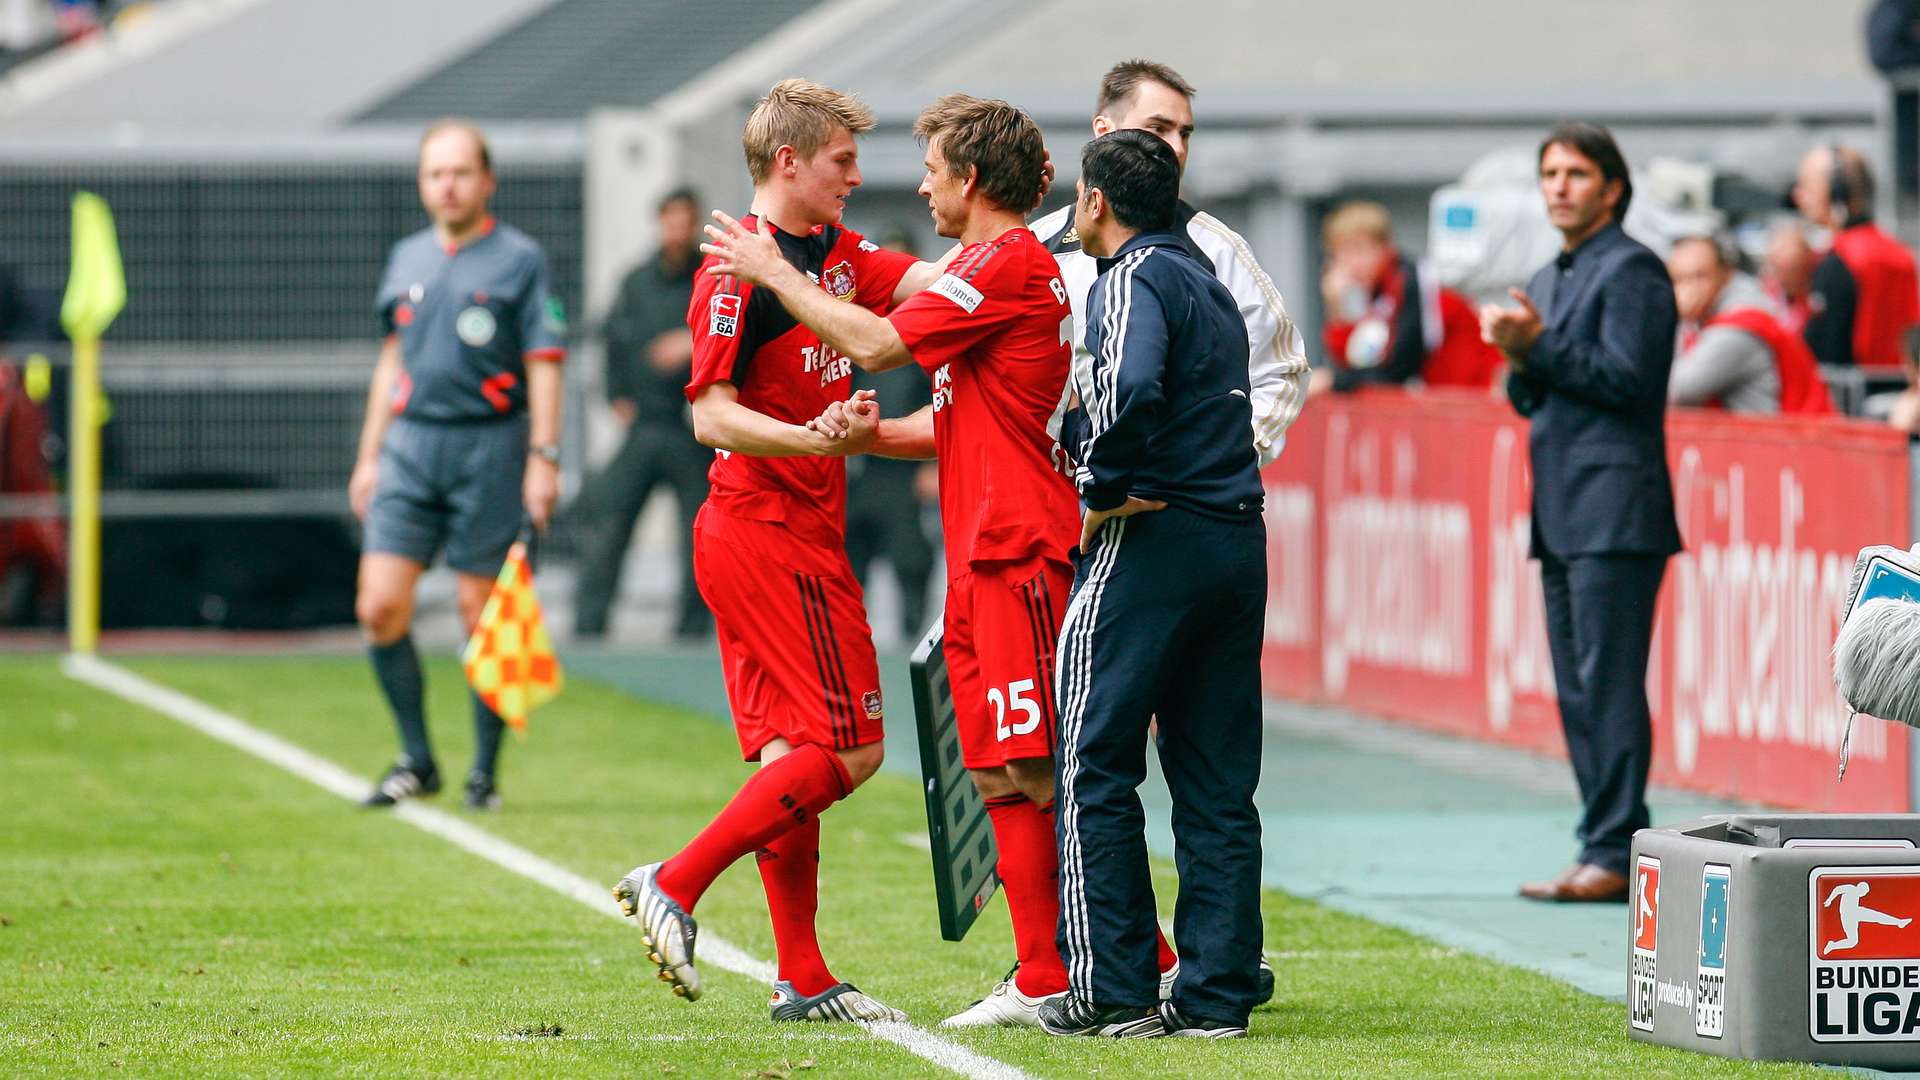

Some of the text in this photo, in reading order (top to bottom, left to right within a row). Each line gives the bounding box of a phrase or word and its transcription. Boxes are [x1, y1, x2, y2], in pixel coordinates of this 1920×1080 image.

[987, 678, 1041, 743] 25
[1633, 953, 1656, 980] BUNDES
[1816, 966, 1920, 989] BUNDE
[1633, 979, 1654, 1026] LIGA
[1656, 977, 1694, 1016] produced by
[1697, 973, 1725, 1007] SPORT
[1696, 1007, 1724, 1030] CAST
